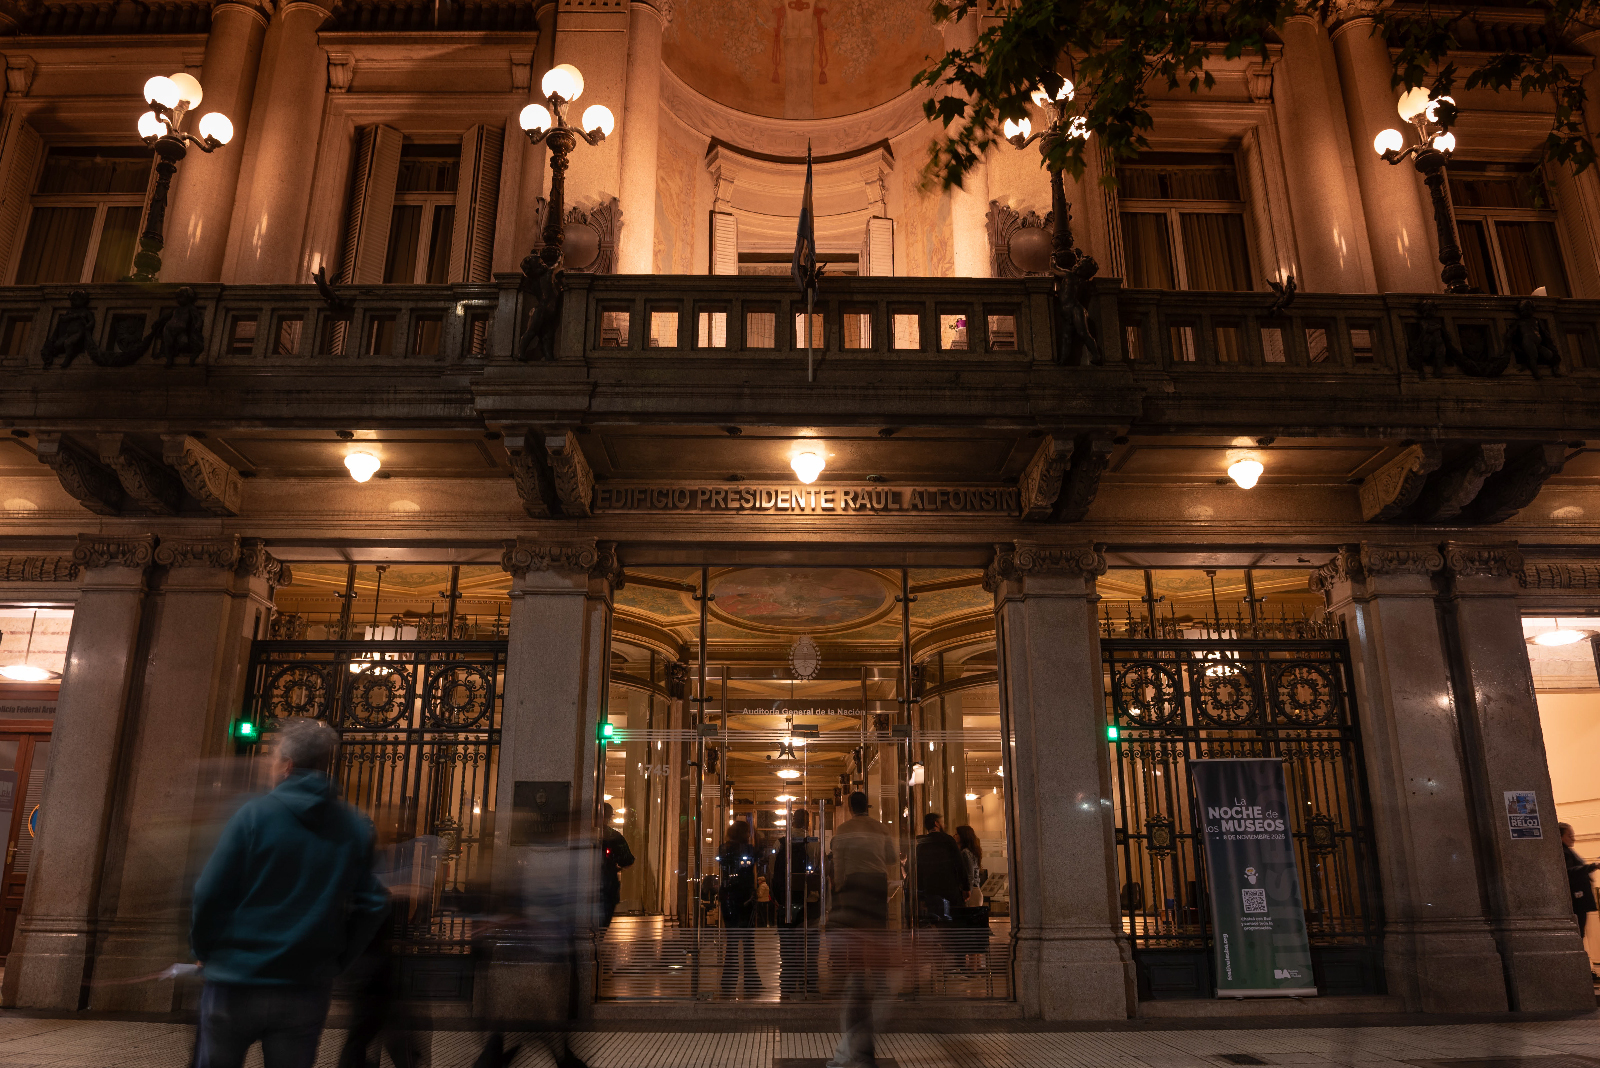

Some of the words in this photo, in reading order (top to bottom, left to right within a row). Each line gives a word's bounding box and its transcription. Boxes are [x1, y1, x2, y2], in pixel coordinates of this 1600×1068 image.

[597, 487, 690, 509] EDIFICIO
[697, 487, 835, 509] PRESIDENTE
[42, 706, 56, 714] Arge
[782, 707, 814, 715] General
[838, 707, 866, 715] Nación
[637, 764, 670, 776] 1745
[1234, 797, 1247, 806] La
[1208, 806, 1263, 819] NOCHE
[1265, 810, 1279, 819] de
[1205, 824, 1219, 833] los
[1220, 819, 1285, 832] MUSEOS
[1511, 819, 1538, 827] RELOJ
